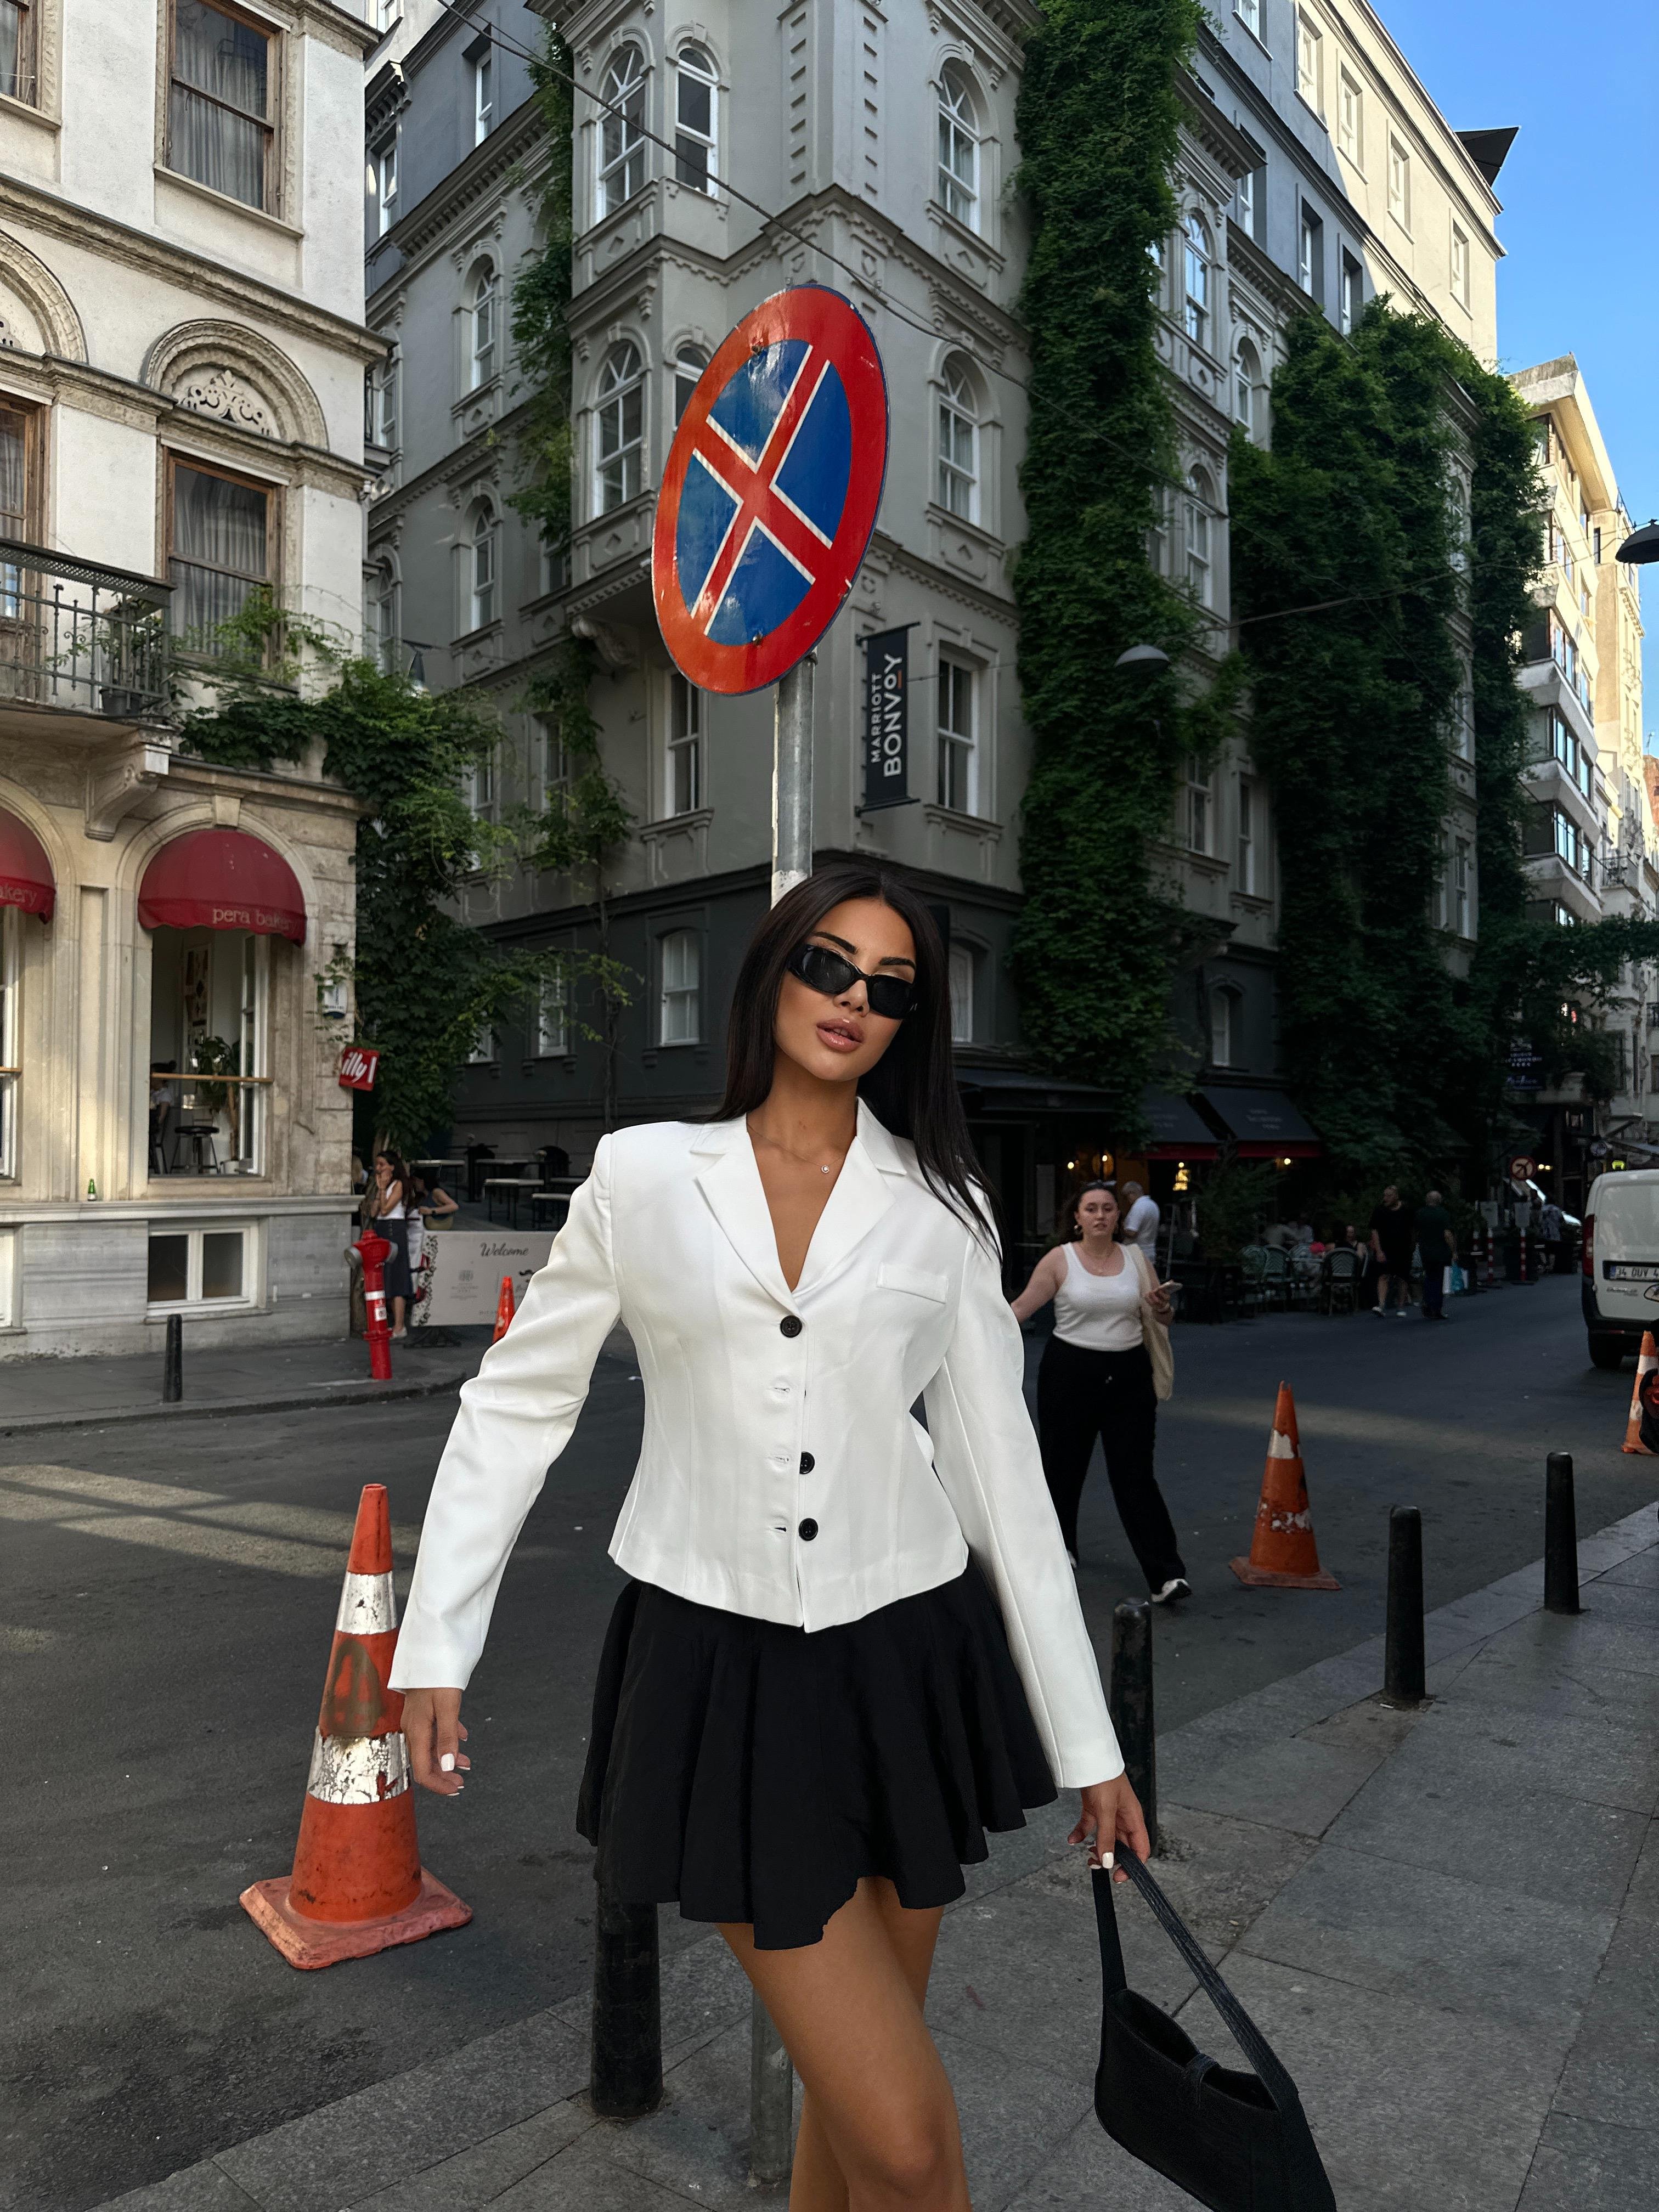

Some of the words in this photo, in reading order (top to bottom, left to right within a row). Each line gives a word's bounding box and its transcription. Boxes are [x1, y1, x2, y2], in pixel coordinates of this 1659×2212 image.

[871, 673, 882, 763] MARRIOTT
[883, 653, 902, 777] BONVOY
[212, 908, 251, 924] pera
[255, 909, 298, 934] bakery
[341, 1051, 368, 1084] illy
[479, 1242, 530, 1257] Welcome
